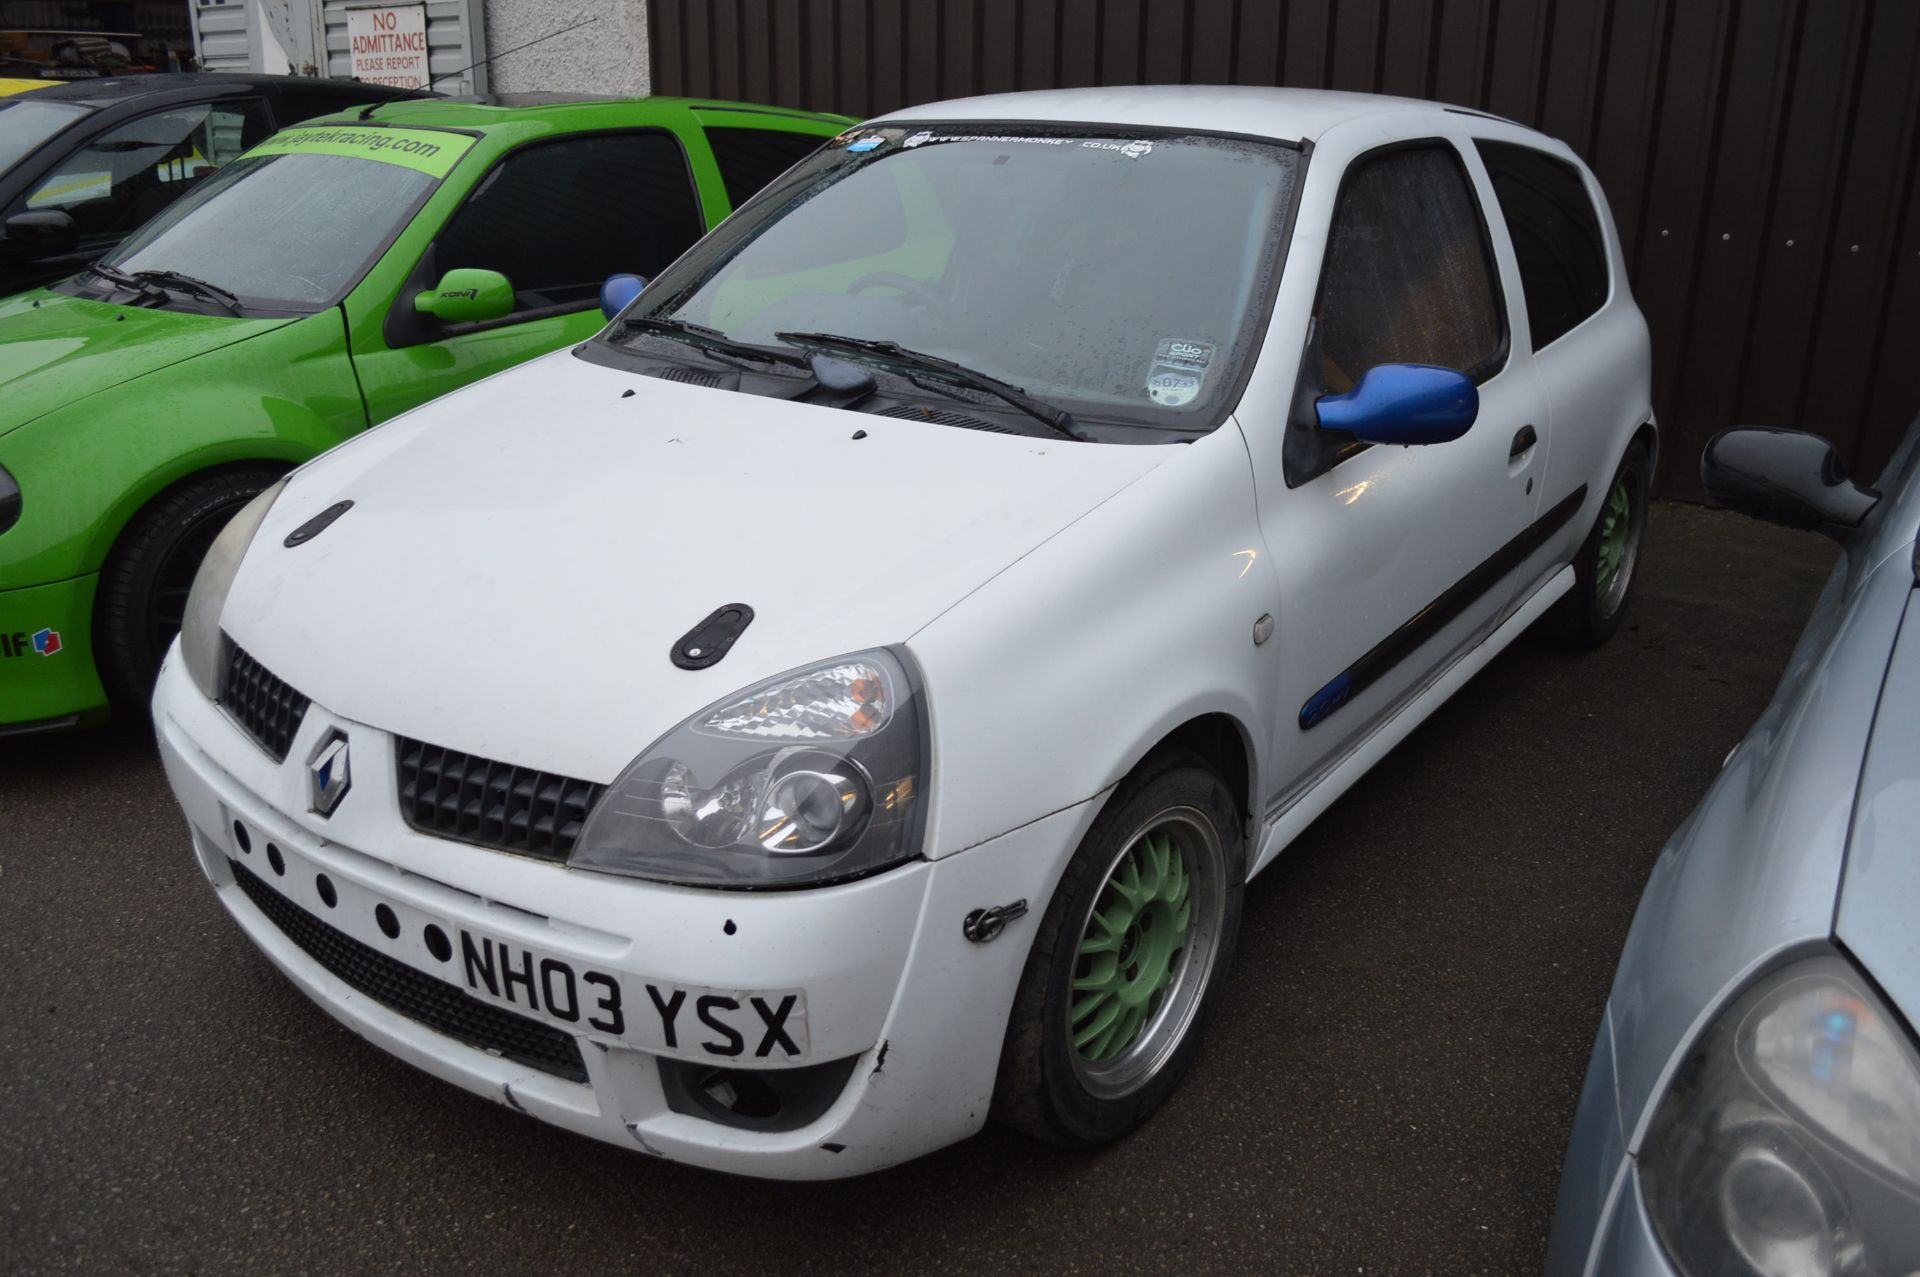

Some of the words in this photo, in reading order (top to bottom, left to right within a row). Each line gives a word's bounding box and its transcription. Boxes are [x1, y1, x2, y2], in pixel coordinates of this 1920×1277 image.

[373, 11, 397, 31] NO
[352, 32, 425, 54] ADMITTANCE
[356, 58, 384, 71] PLEASE
[386, 56, 420, 70] REPORT
[460, 929, 625, 1035] NH03
[645, 983, 801, 1058] YSX
